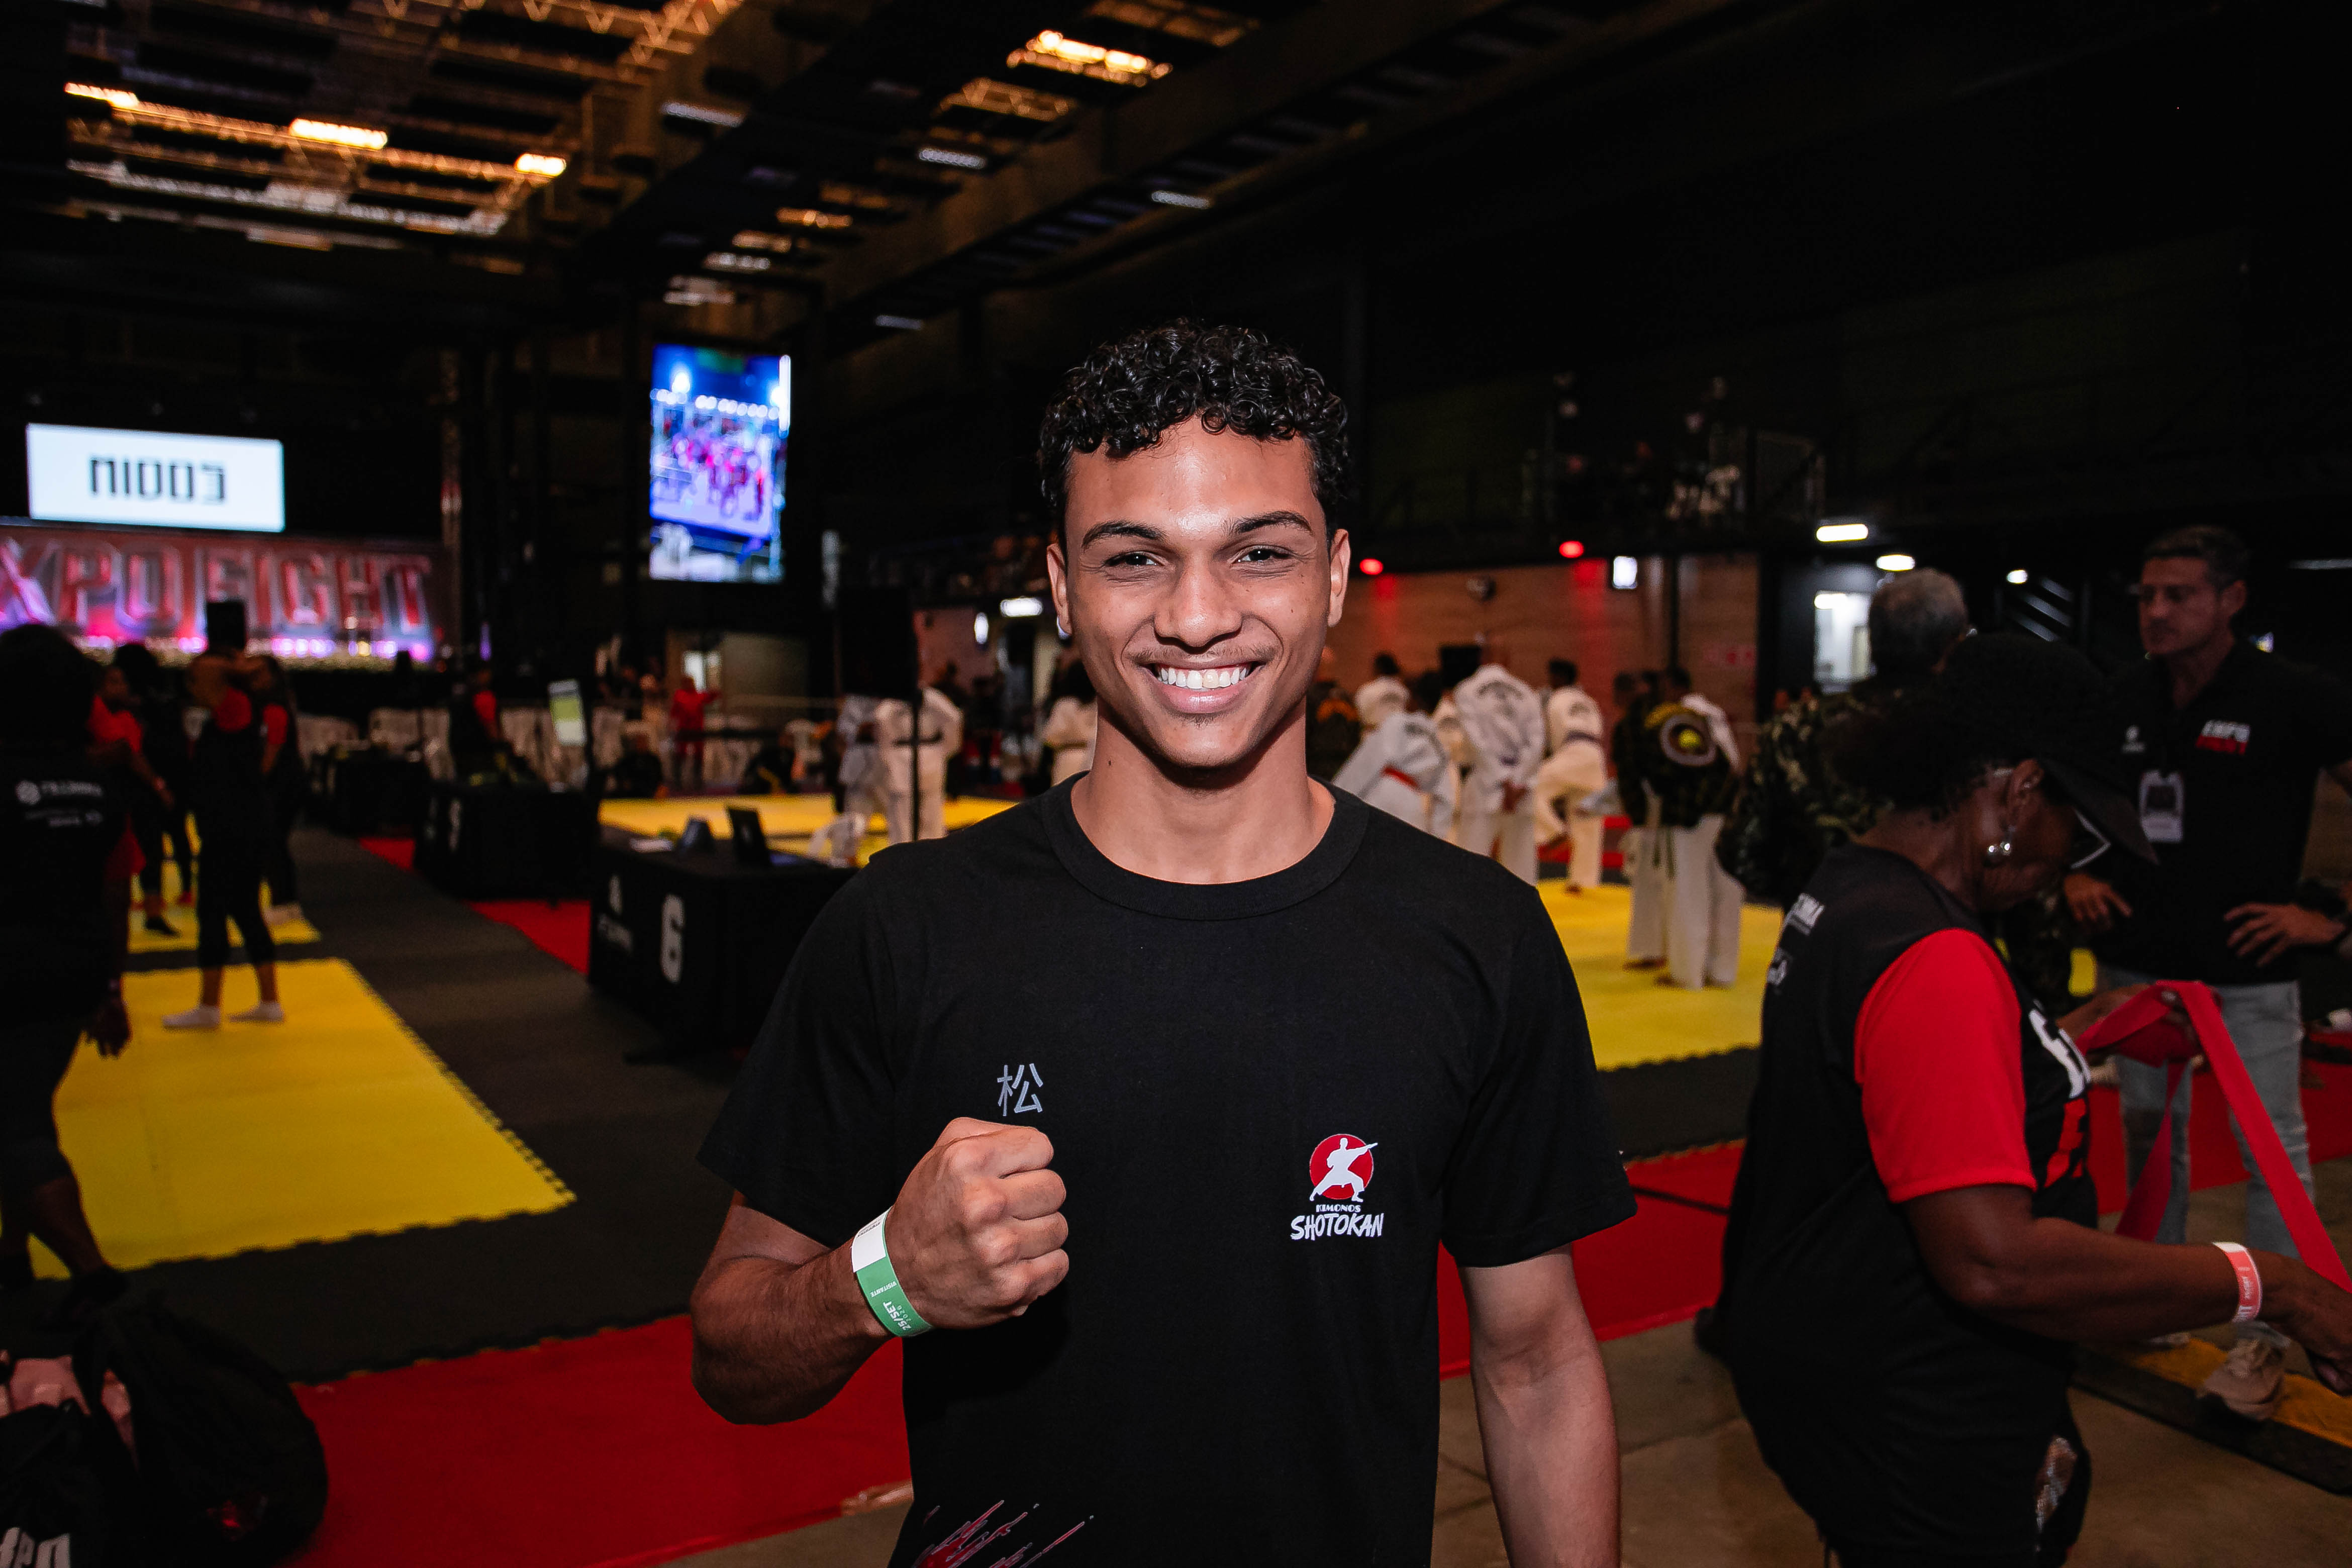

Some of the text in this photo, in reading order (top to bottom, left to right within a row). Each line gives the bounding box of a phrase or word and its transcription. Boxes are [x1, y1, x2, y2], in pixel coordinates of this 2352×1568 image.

[660, 893, 685, 985] 6
[997, 1062, 1043, 1117] 松
[1316, 1204, 1361, 1213] KIMONOS
[1290, 1213, 1385, 1240] SHOTOKAN
[870, 1281, 897, 1298] VISITANTE
[883, 1301, 911, 1330] 25/SET
